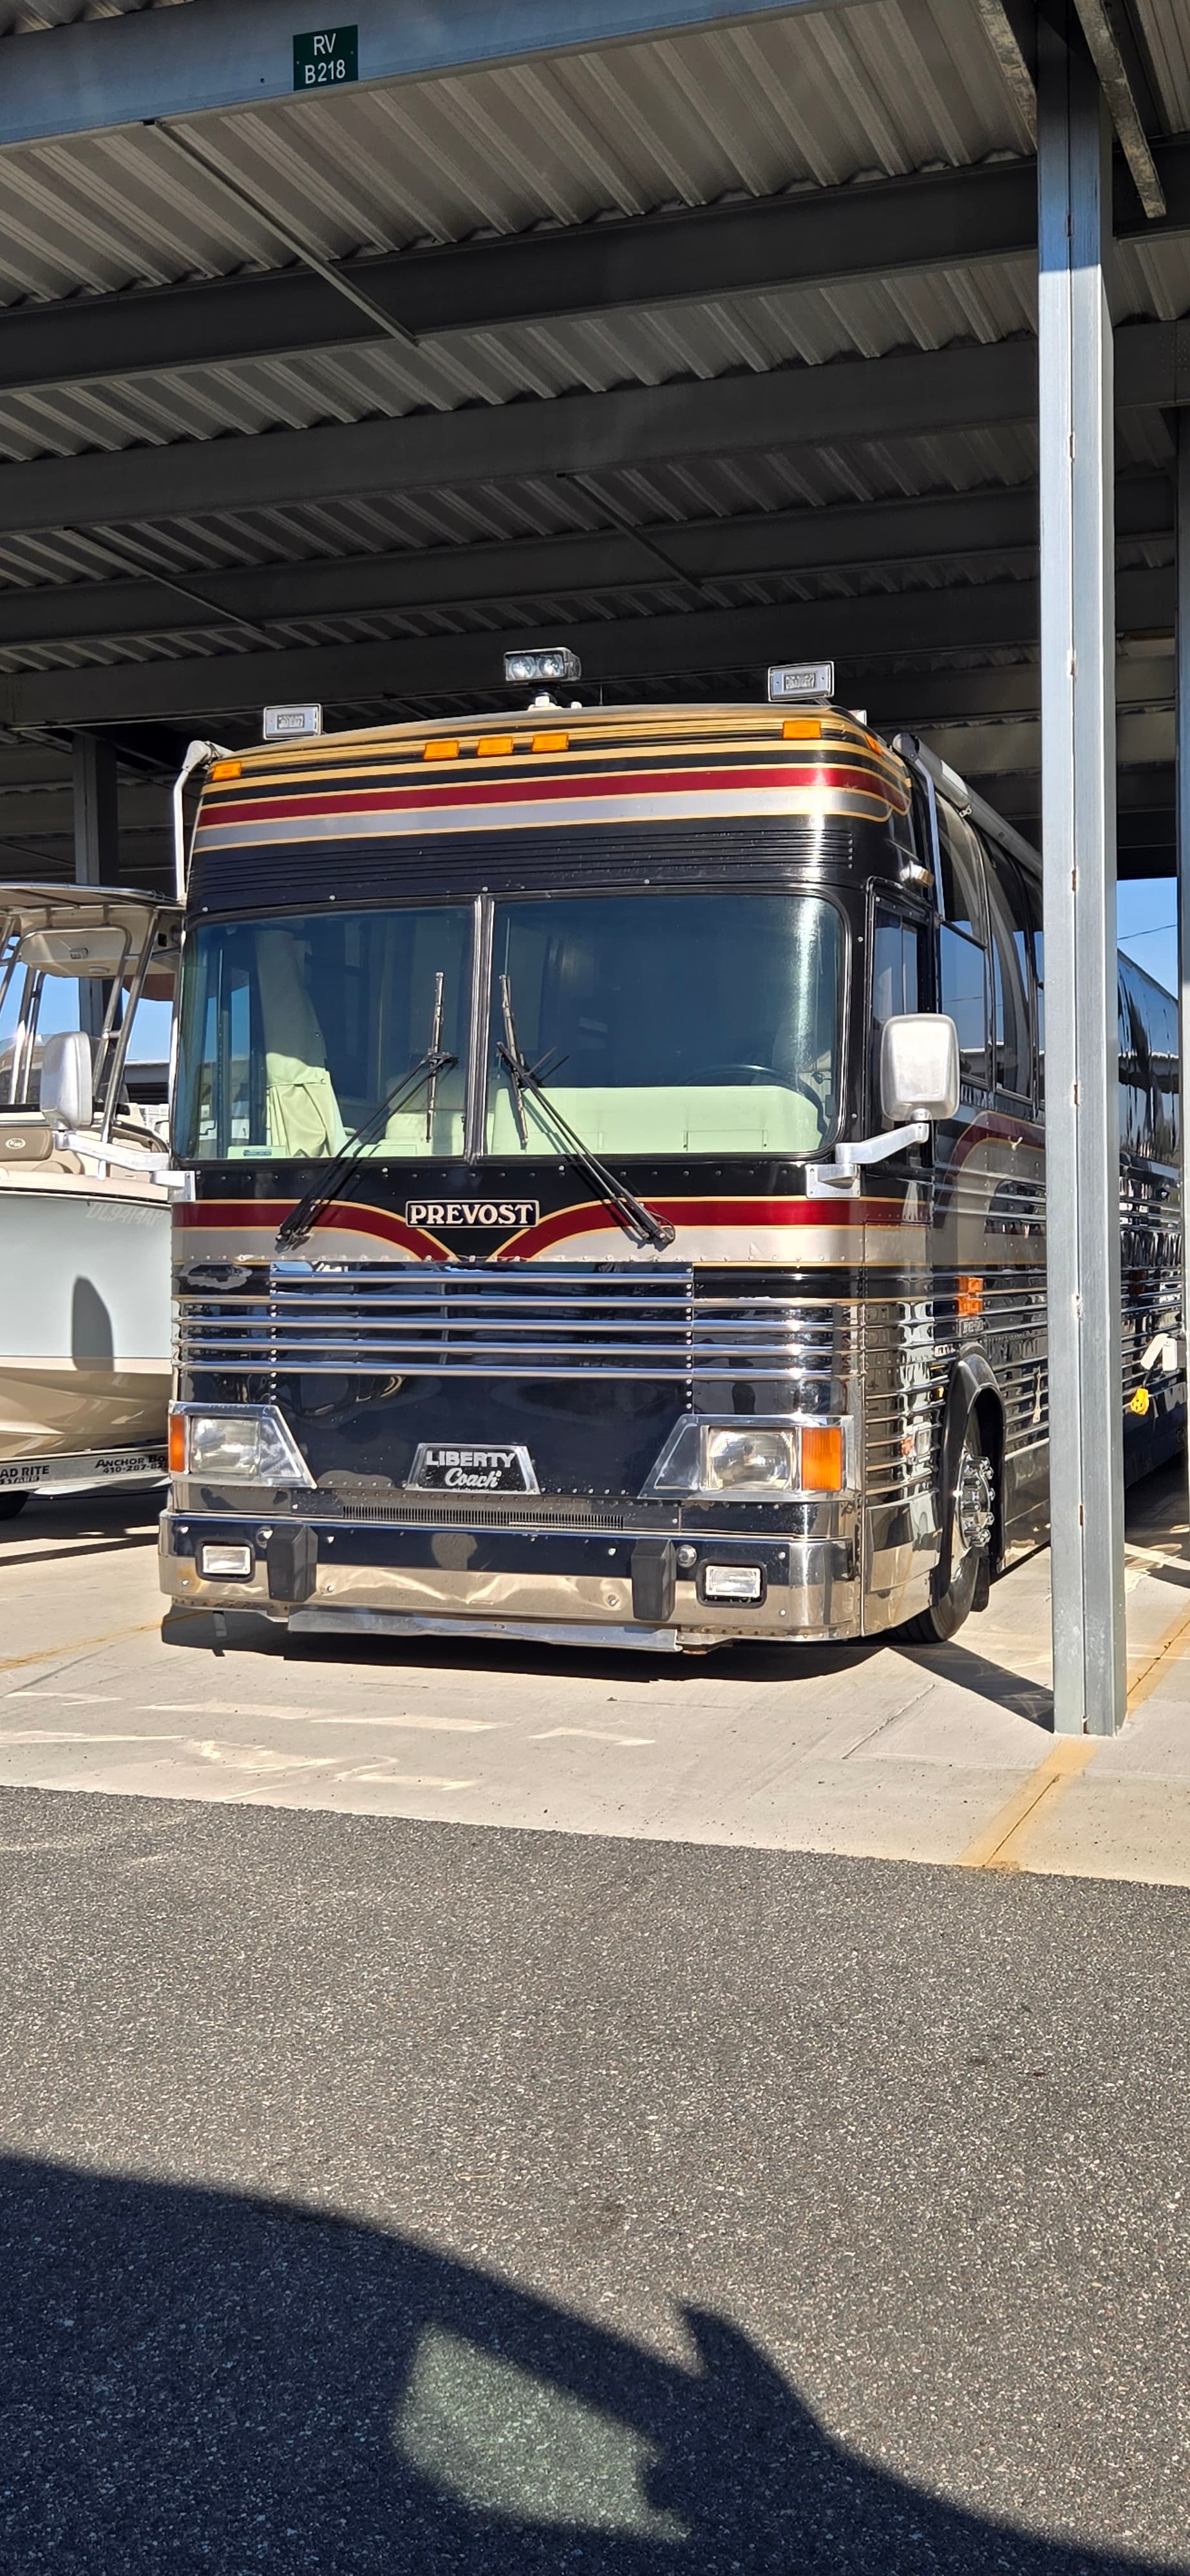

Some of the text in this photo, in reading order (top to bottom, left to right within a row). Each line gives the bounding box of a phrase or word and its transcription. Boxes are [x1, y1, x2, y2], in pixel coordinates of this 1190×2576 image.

[314, 33, 336, 56] RV
[305, 59, 346, 84] B218
[410, 1204, 533, 1225] PREVOST
[103, 1462, 169, 1474] 410-287-82
[426, 1450, 516, 1468] LIBERTY
[22, 1464, 50, 1477] RITE
[444, 1467, 500, 1488] Coach
